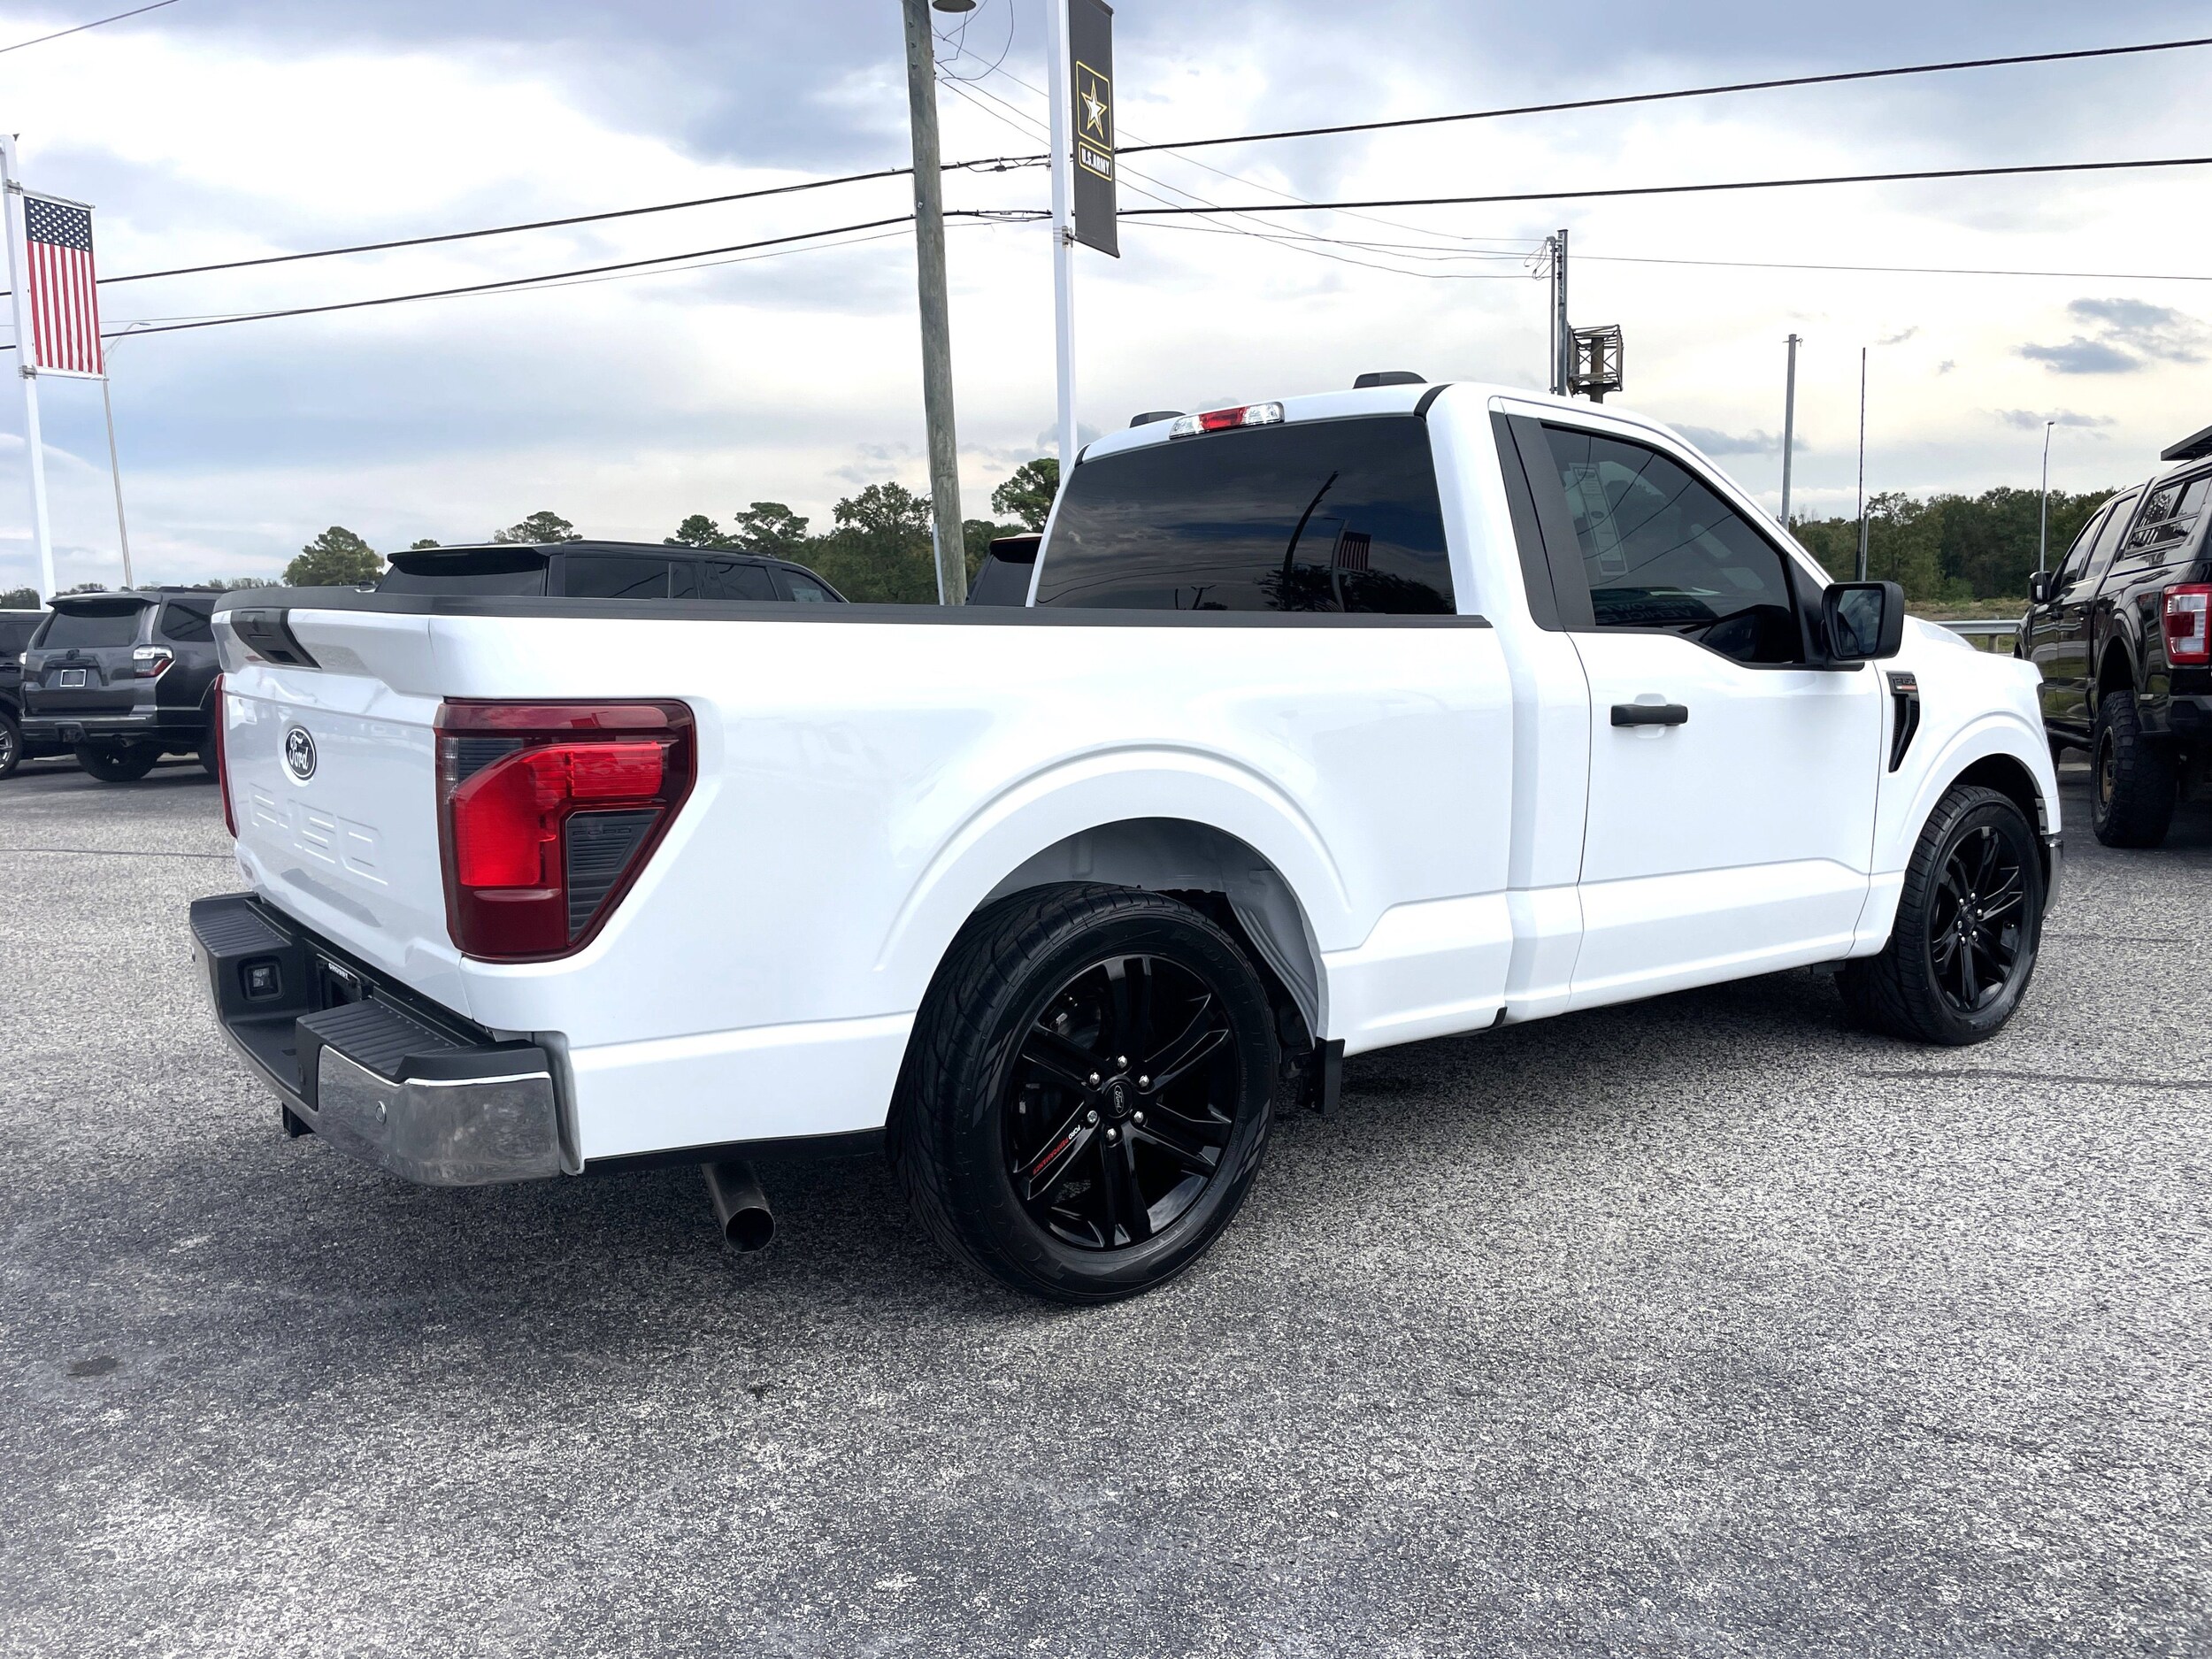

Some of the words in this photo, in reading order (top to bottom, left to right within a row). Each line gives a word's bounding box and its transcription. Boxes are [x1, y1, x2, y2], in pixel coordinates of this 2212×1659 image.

[288, 731, 310, 772] Ford
[249, 781, 388, 887] F-150
[572, 827, 632, 836] FORD
[1068, 1124, 1081, 1141] FORD
[1033, 1136, 1070, 1176] PERFORMANCE
